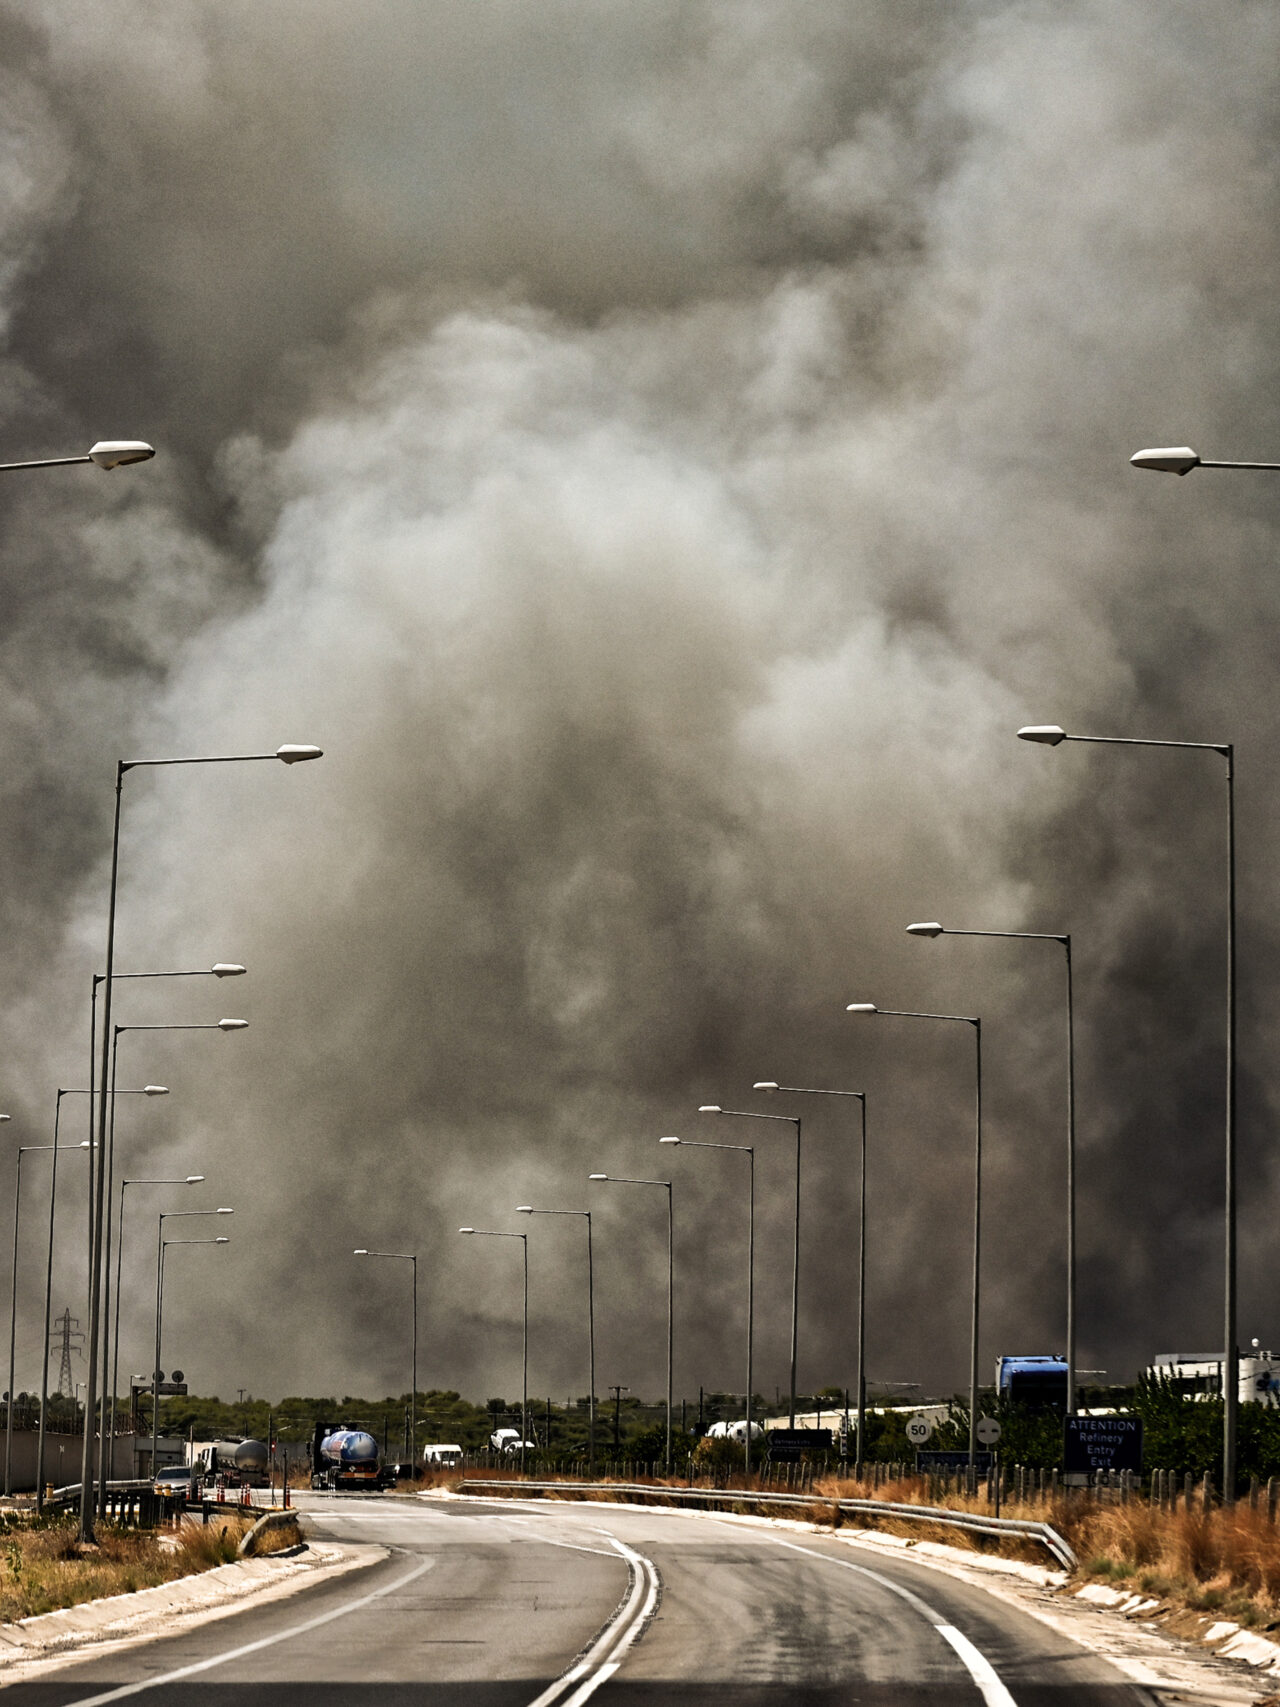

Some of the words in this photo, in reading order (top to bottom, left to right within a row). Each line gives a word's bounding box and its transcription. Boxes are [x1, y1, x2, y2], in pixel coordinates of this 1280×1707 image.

[911, 1425, 926, 1435] 50
[1069, 1420, 1136, 1431] ATTENTION
[1080, 1432, 1123, 1444] Refinery
[1087, 1445, 1115, 1456] Entry
[1090, 1457, 1112, 1467] Exit
